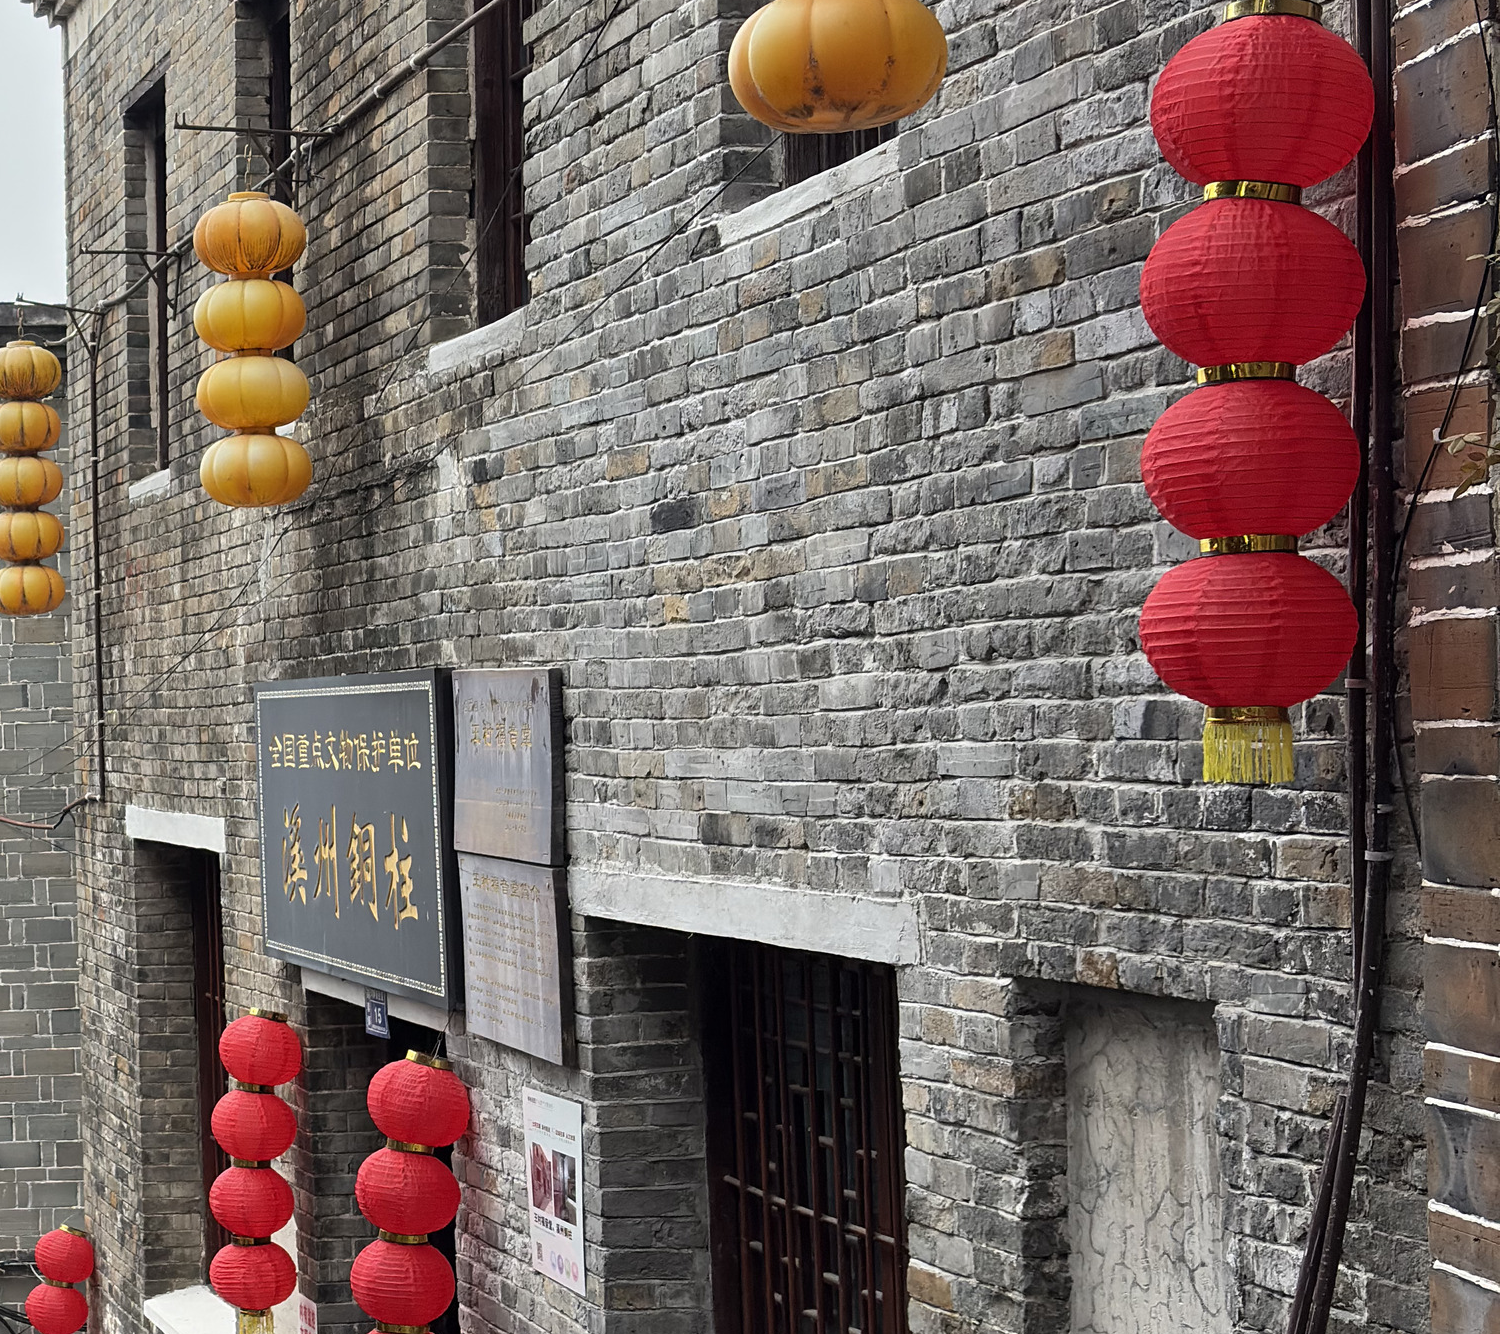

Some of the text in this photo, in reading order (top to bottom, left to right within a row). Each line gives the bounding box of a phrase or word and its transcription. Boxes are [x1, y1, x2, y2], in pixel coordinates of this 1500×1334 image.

[268, 729, 422, 774] 全国重点文物保护单位
[373, 1007, 382, 1025] 15
